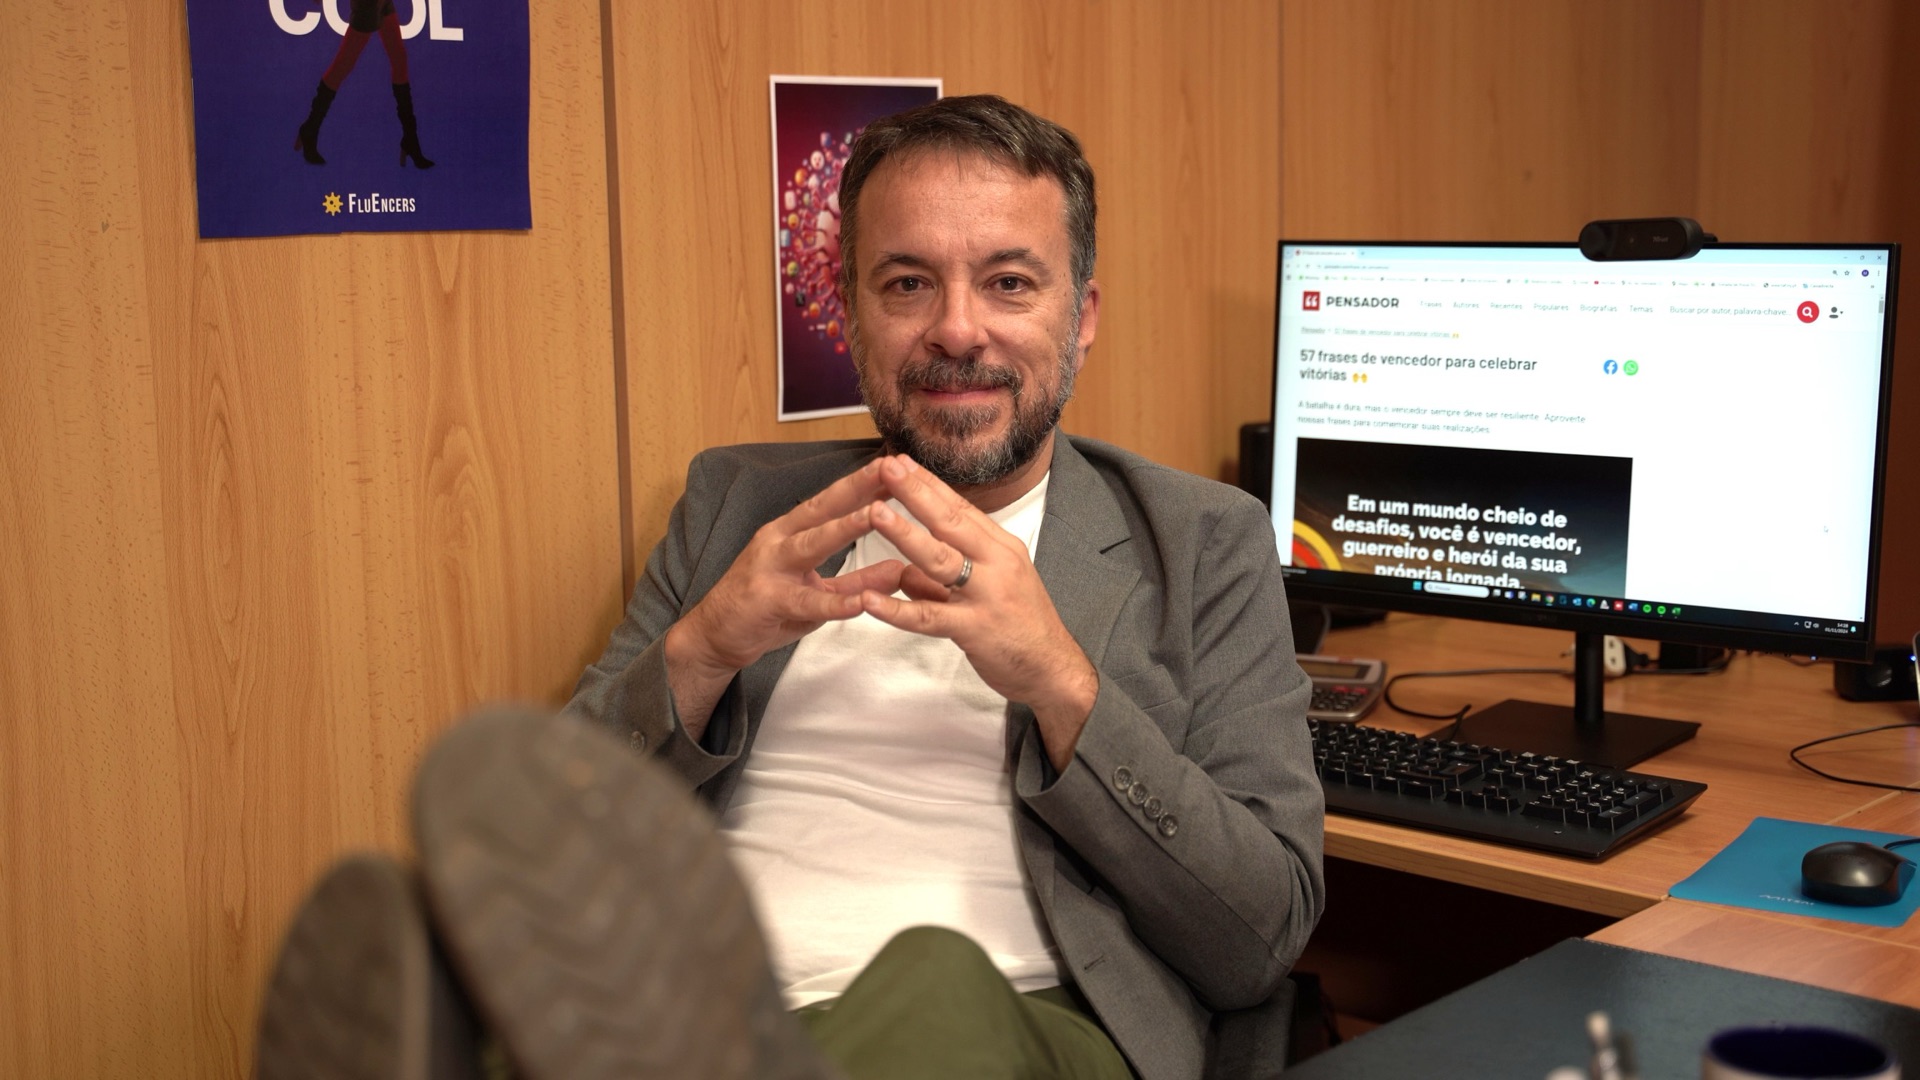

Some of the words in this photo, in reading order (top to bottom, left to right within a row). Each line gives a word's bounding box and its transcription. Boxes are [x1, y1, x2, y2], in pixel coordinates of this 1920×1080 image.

[1326, 295, 1399, 309] PENSADOR
[1453, 301, 1480, 309] Autores
[1490, 302, 1523, 310] Recentes
[1533, 303, 1569, 312] Populares
[1580, 304, 1618, 313] Biografias
[1629, 305, 1653, 313] Temas
[1670, 305, 1695, 314] Buscar
[1696, 308, 1709, 316] por
[1711, 307, 1732, 316] autor,
[1300, 349, 1315, 362] 57
[1318, 350, 1358, 364] frases
[1361, 352, 1377, 365] de
[1380, 354, 1442, 367] vencedor
[1445, 357, 1475, 370] para
[1479, 357, 1537, 371] celebrar
[1299, 368, 1348, 381] vitórias
[1306, 401, 1334, 410] batalha
[1391, 406, 1427, 415] vencedor
[1431, 408, 1460, 418] sempre
[1463, 409, 1483, 418] deve
[1485, 411, 1498, 419] ser
[1544, 413, 1586, 424] Aproveite
[1297, 416, 1325, 425] nossas
[1327, 416, 1351, 426] frases
[1353, 419, 1371, 428] para
[1373, 420, 1419, 430] comemorar
[1421, 423, 1440, 431] suas
[1347, 494, 1376, 513] Em
[1379, 499, 1409, 516] um
[1412, 502, 1480, 522] mundo
[1483, 505, 1537, 526] cheio
[1540, 509, 1568, 529] de
[1331, 514, 1415, 541] desafios,
[1418, 523, 1464, 542] você
[1467, 525, 1480, 543] é
[1483, 529, 1582, 555] vencedor,
[1342, 538, 1429, 561] guerreiro
[1432, 548, 1445, 562] e
[1448, 545, 1499, 567] herói
[1501, 551, 1527, 571] da
[1530, 556, 1568, 574] sua
